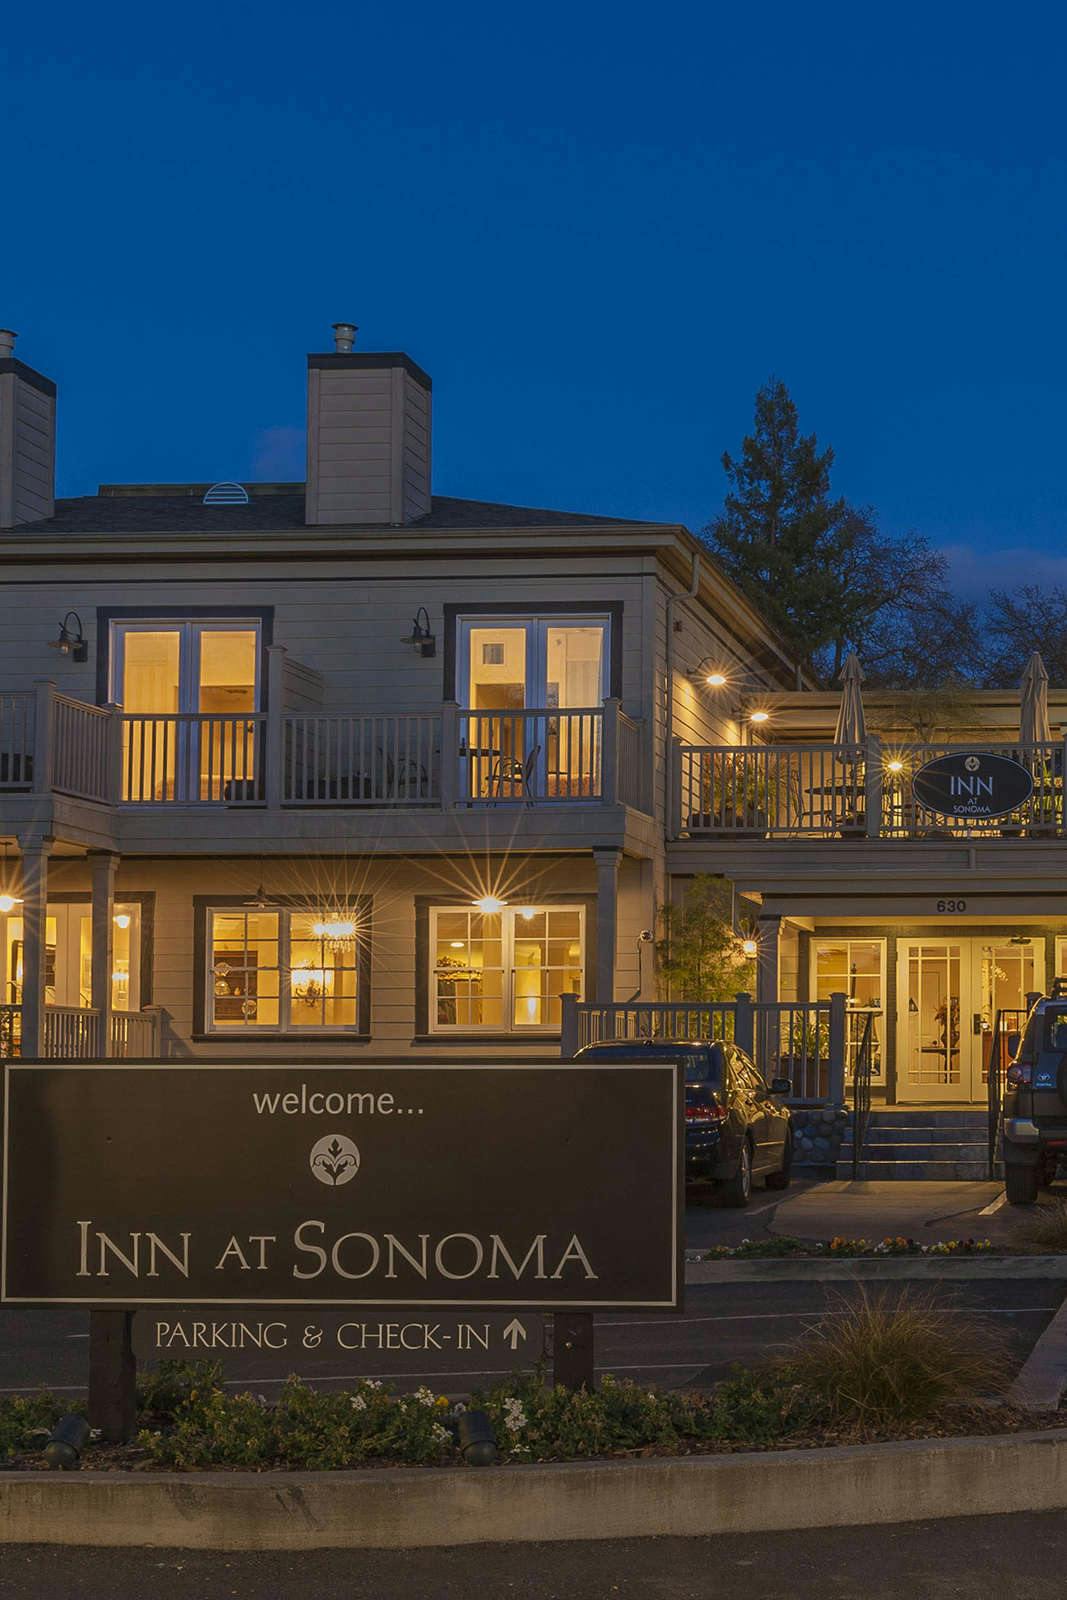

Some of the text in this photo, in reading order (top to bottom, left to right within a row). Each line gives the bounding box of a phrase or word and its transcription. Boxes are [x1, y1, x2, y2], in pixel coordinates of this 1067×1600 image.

[951, 775, 993, 796] INN
[953, 804, 991, 814] SONOMA
[967, 797, 977, 805] AT
[936, 900, 967, 912] 630
[253, 1085, 424, 1115] welcome...
[76, 1220, 599, 1280] INN AT SONOMA
[155, 1322, 491, 1350] PARKING & CHECK-IN
